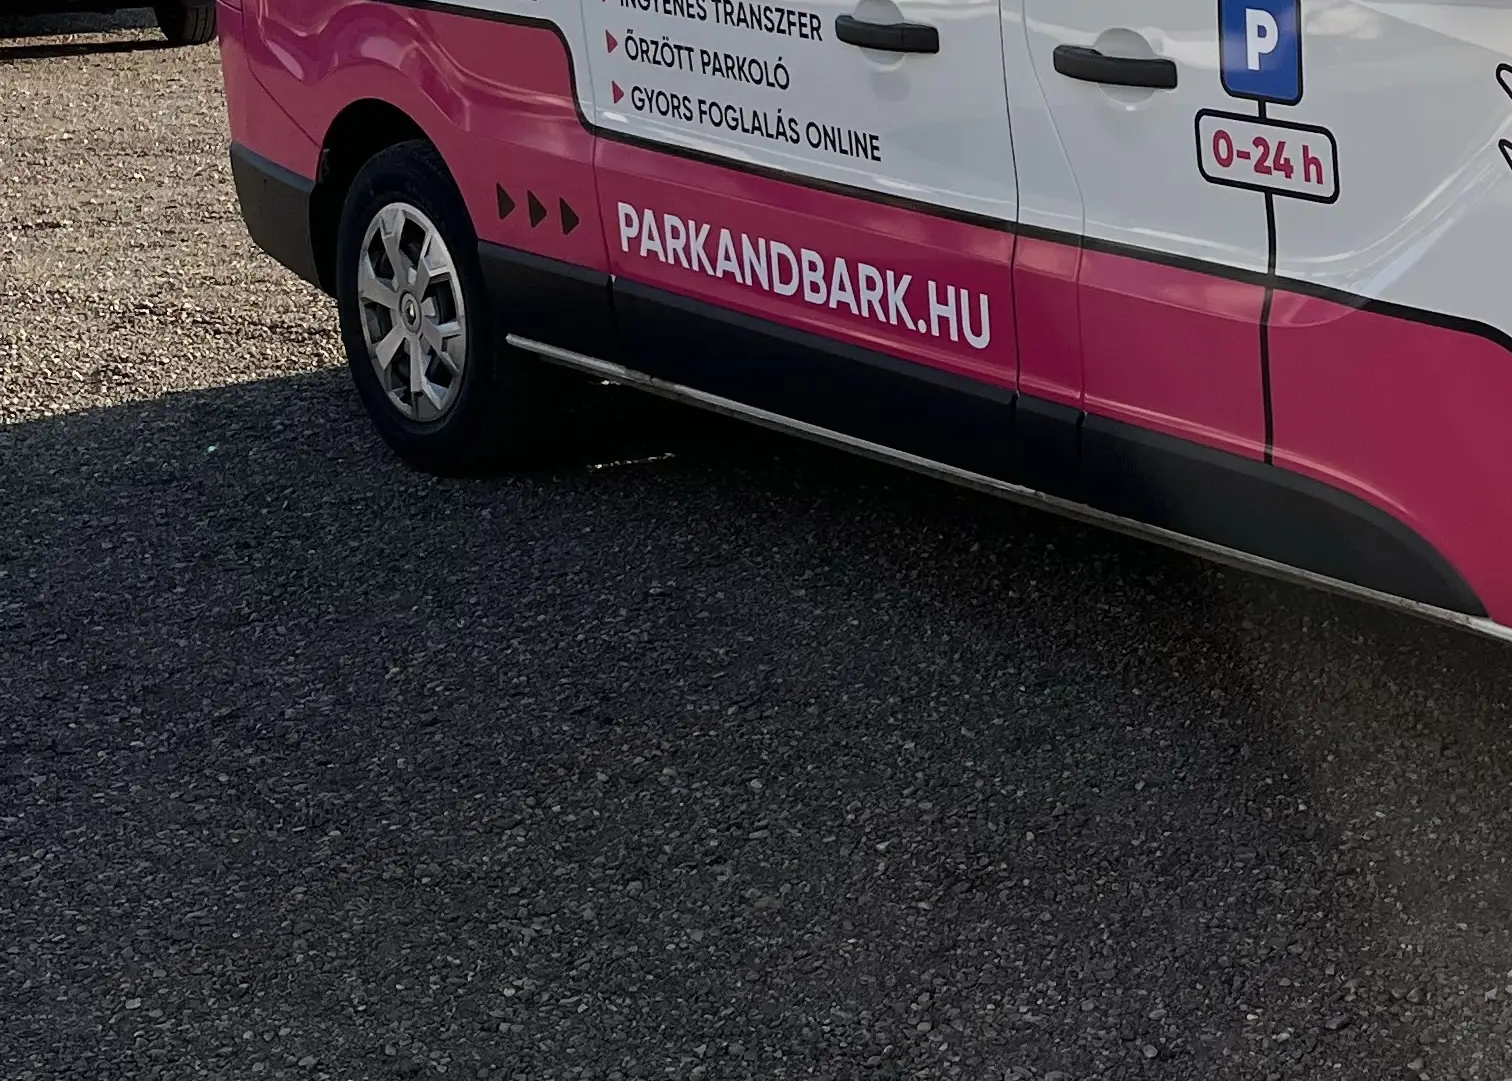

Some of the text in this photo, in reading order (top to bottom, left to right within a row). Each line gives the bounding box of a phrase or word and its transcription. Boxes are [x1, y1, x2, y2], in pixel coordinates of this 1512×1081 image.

[624, 28, 790, 91] ŐRZÖTT PARKOLÓ
[1245, 8, 1279, 71] P
[631, 86, 882, 162] GYORS FOGLALÁS ONLINE
[1212, 128, 1324, 185] 0-24 h
[617, 201, 991, 350] PARKANDBARK.HU
